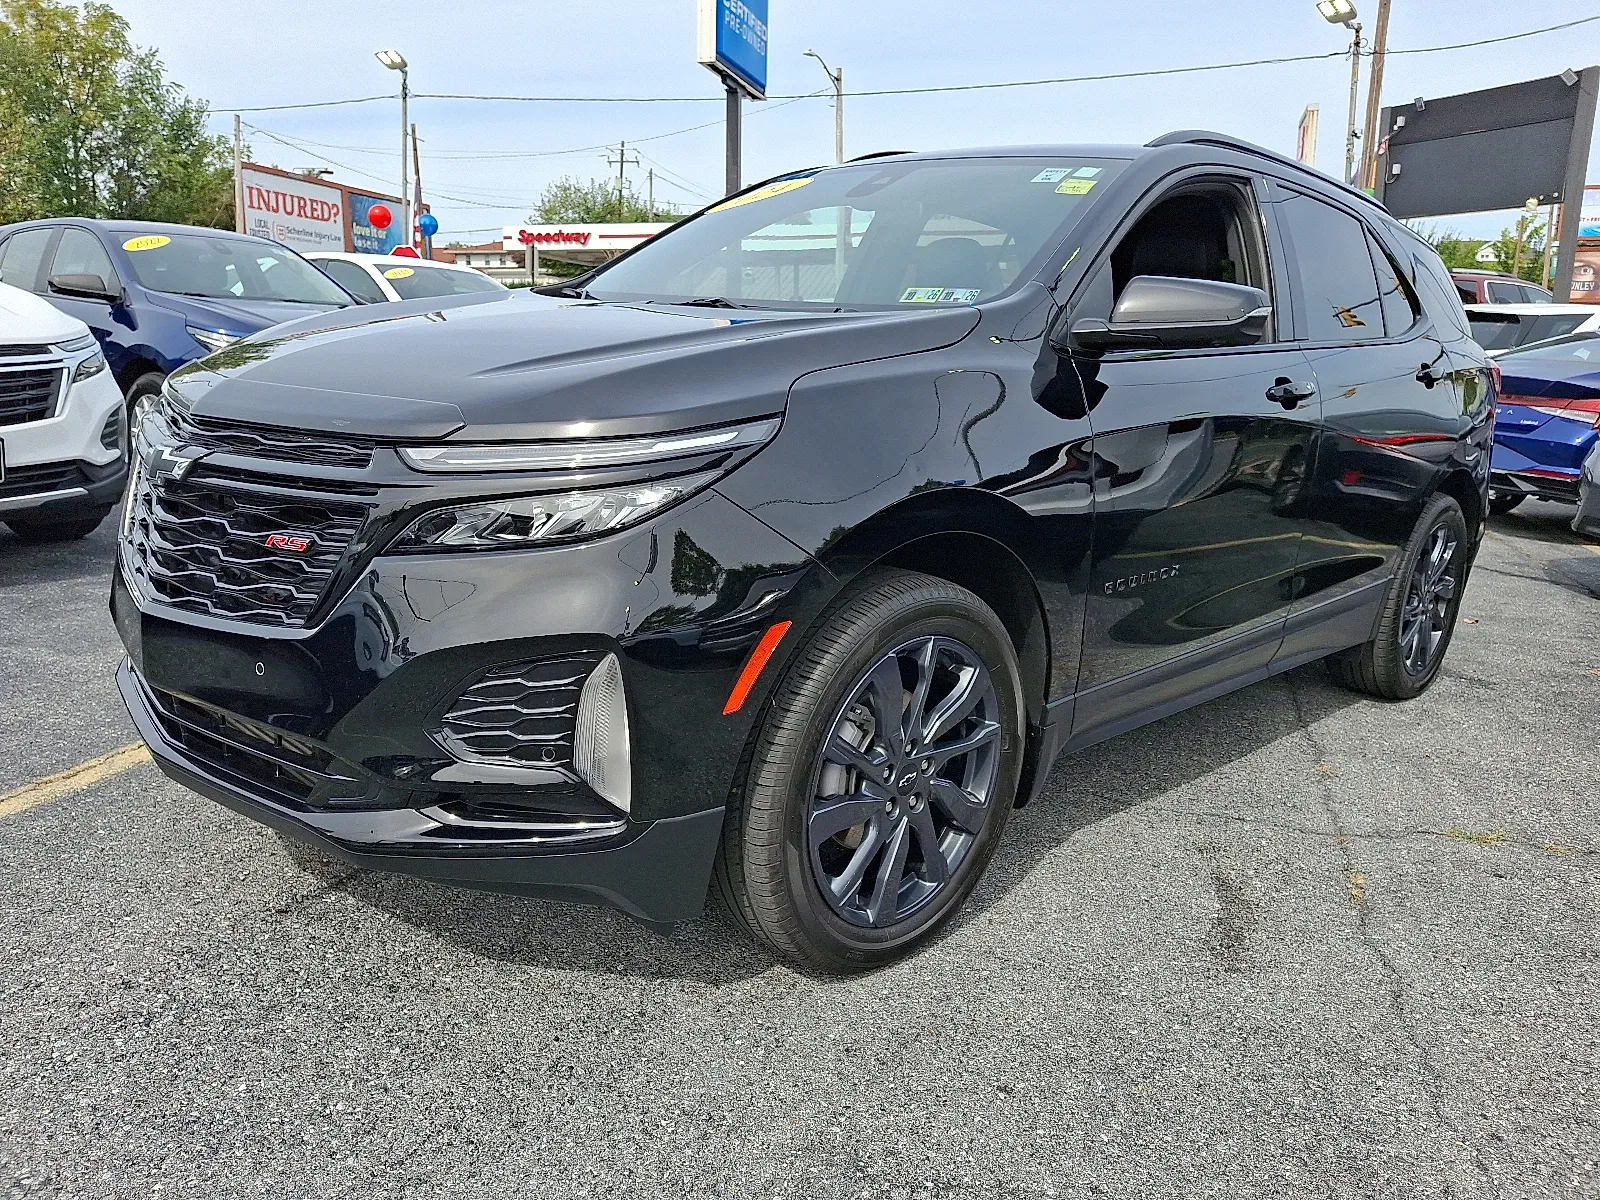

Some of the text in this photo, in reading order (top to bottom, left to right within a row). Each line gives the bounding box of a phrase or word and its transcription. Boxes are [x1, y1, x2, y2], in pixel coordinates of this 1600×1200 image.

[723, 0, 767, 41] CERTIFIED
[725, 10, 766, 55] PRE-OWNED
[246, 186, 340, 224] INJURED?
[254, 217, 271, 230] LOCAL
[314, 230, 330, 241] Injury
[330, 233, 342, 242] Law
[518, 229, 592, 245] Speedway
[904, 289, 941, 301] 10 26
[943, 290, 979, 301] 10 26
[265, 534, 309, 551] RS
[1104, 564, 1180, 594] EQUINOX
